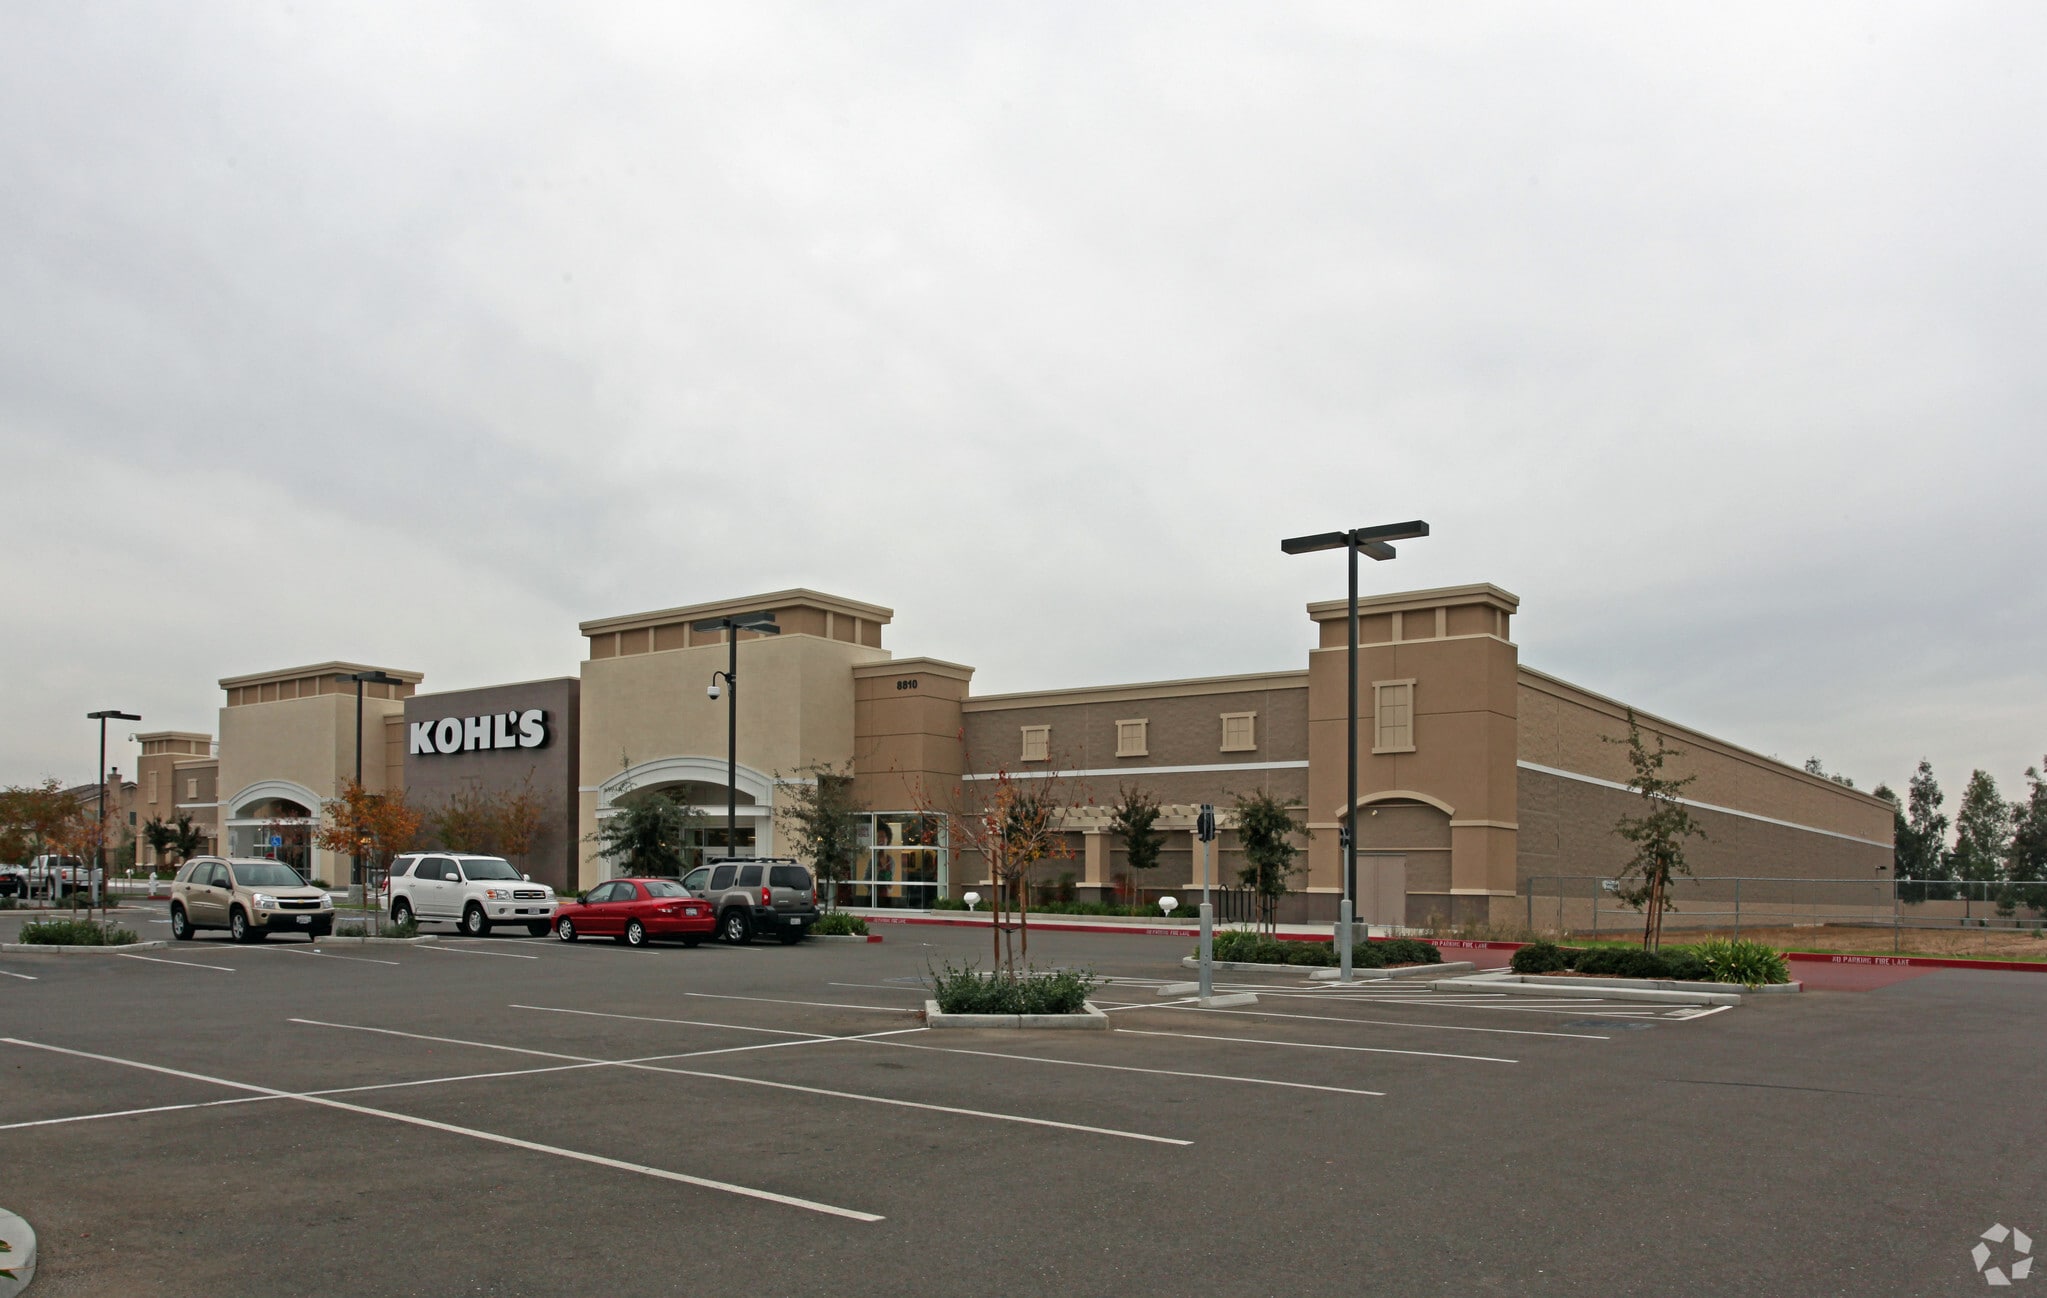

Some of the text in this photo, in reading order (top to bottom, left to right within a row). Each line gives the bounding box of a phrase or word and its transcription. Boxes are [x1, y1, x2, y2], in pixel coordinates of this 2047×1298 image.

[897, 679, 918, 690] 8810
[410, 709, 545, 755] KOHL'S
[1842, 956, 1872, 964] PARKING
[1875, 958, 1890, 966] FIRE
